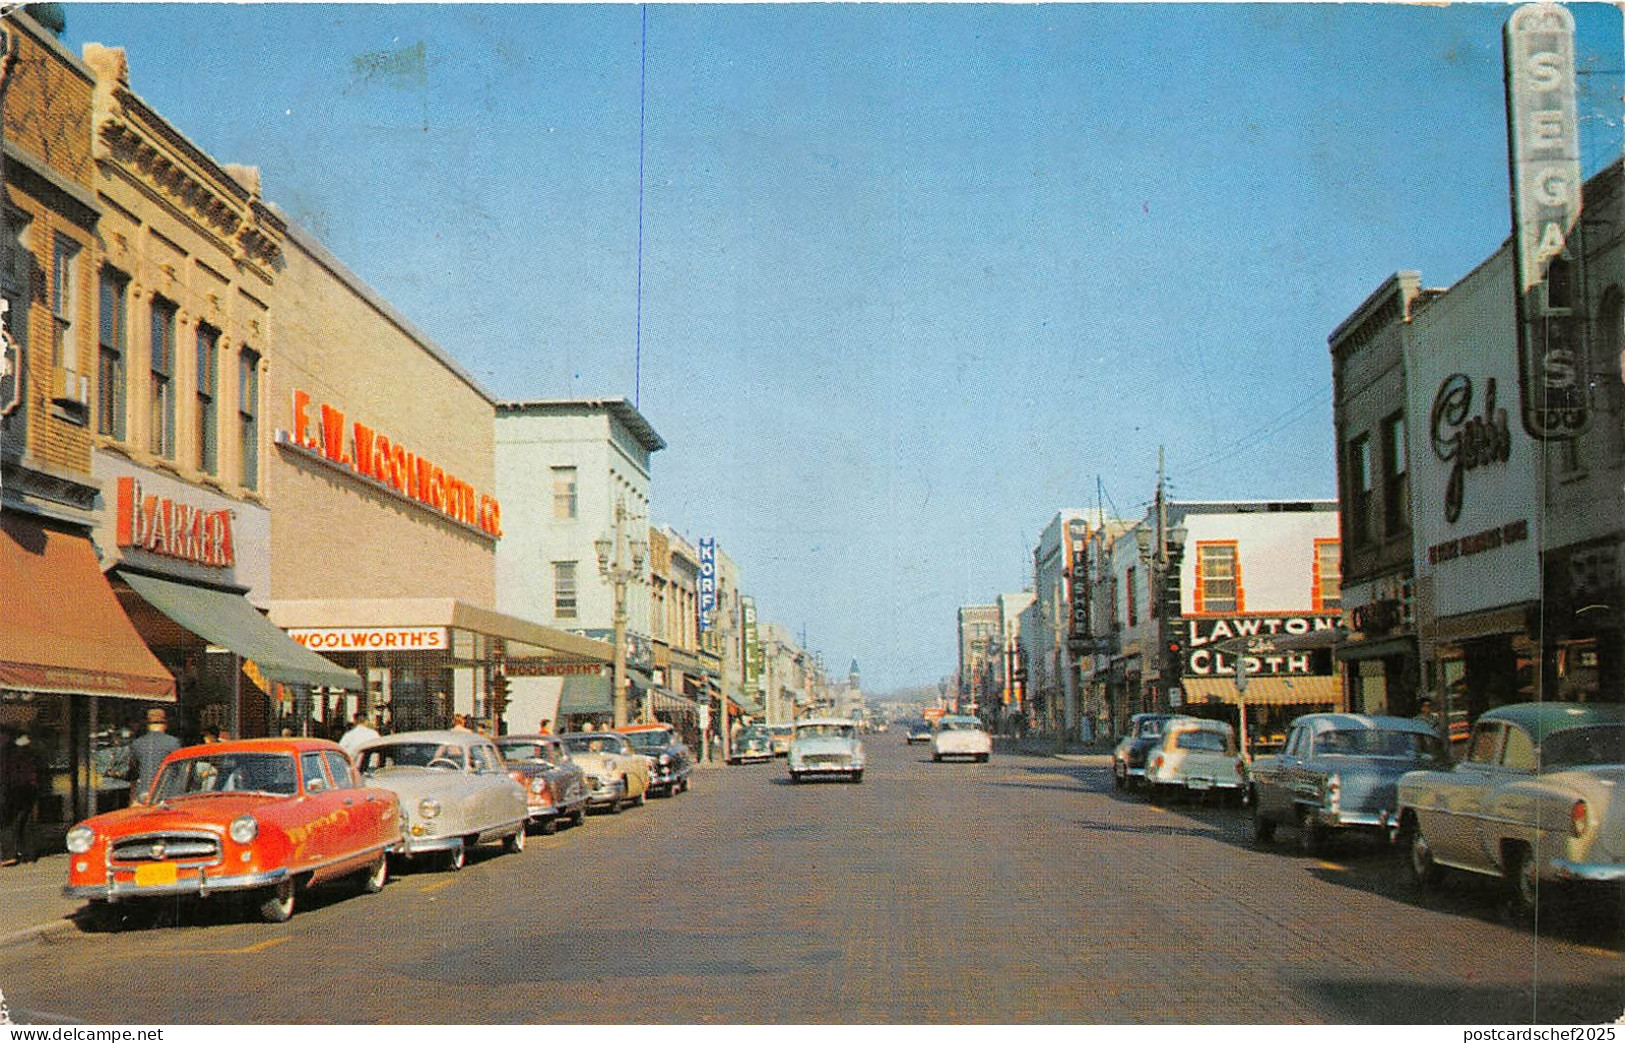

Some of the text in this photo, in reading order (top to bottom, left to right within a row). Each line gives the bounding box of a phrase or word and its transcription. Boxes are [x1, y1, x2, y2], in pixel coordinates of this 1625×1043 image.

[353, 421, 477, 525] WOOLWORTH
[291, 632, 439, 648] WOOLWORTH'S
[1190, 650, 1309, 674] CLOTH
